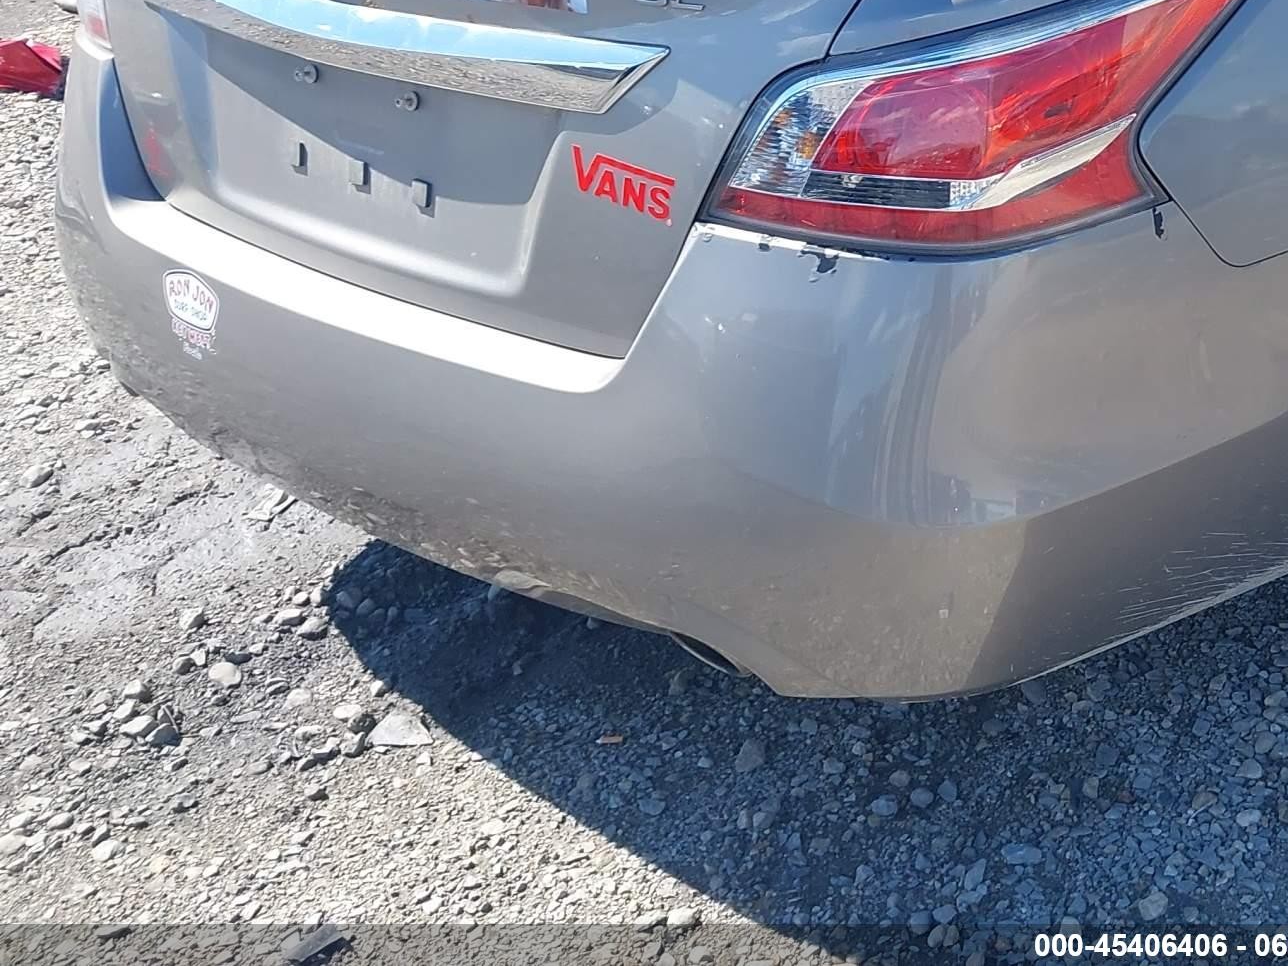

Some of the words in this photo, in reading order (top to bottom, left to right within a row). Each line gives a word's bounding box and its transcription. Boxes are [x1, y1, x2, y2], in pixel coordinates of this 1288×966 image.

[571, 143, 676, 221] VANS
[169, 279, 190, 297] RON
[192, 285, 214, 314] JON
